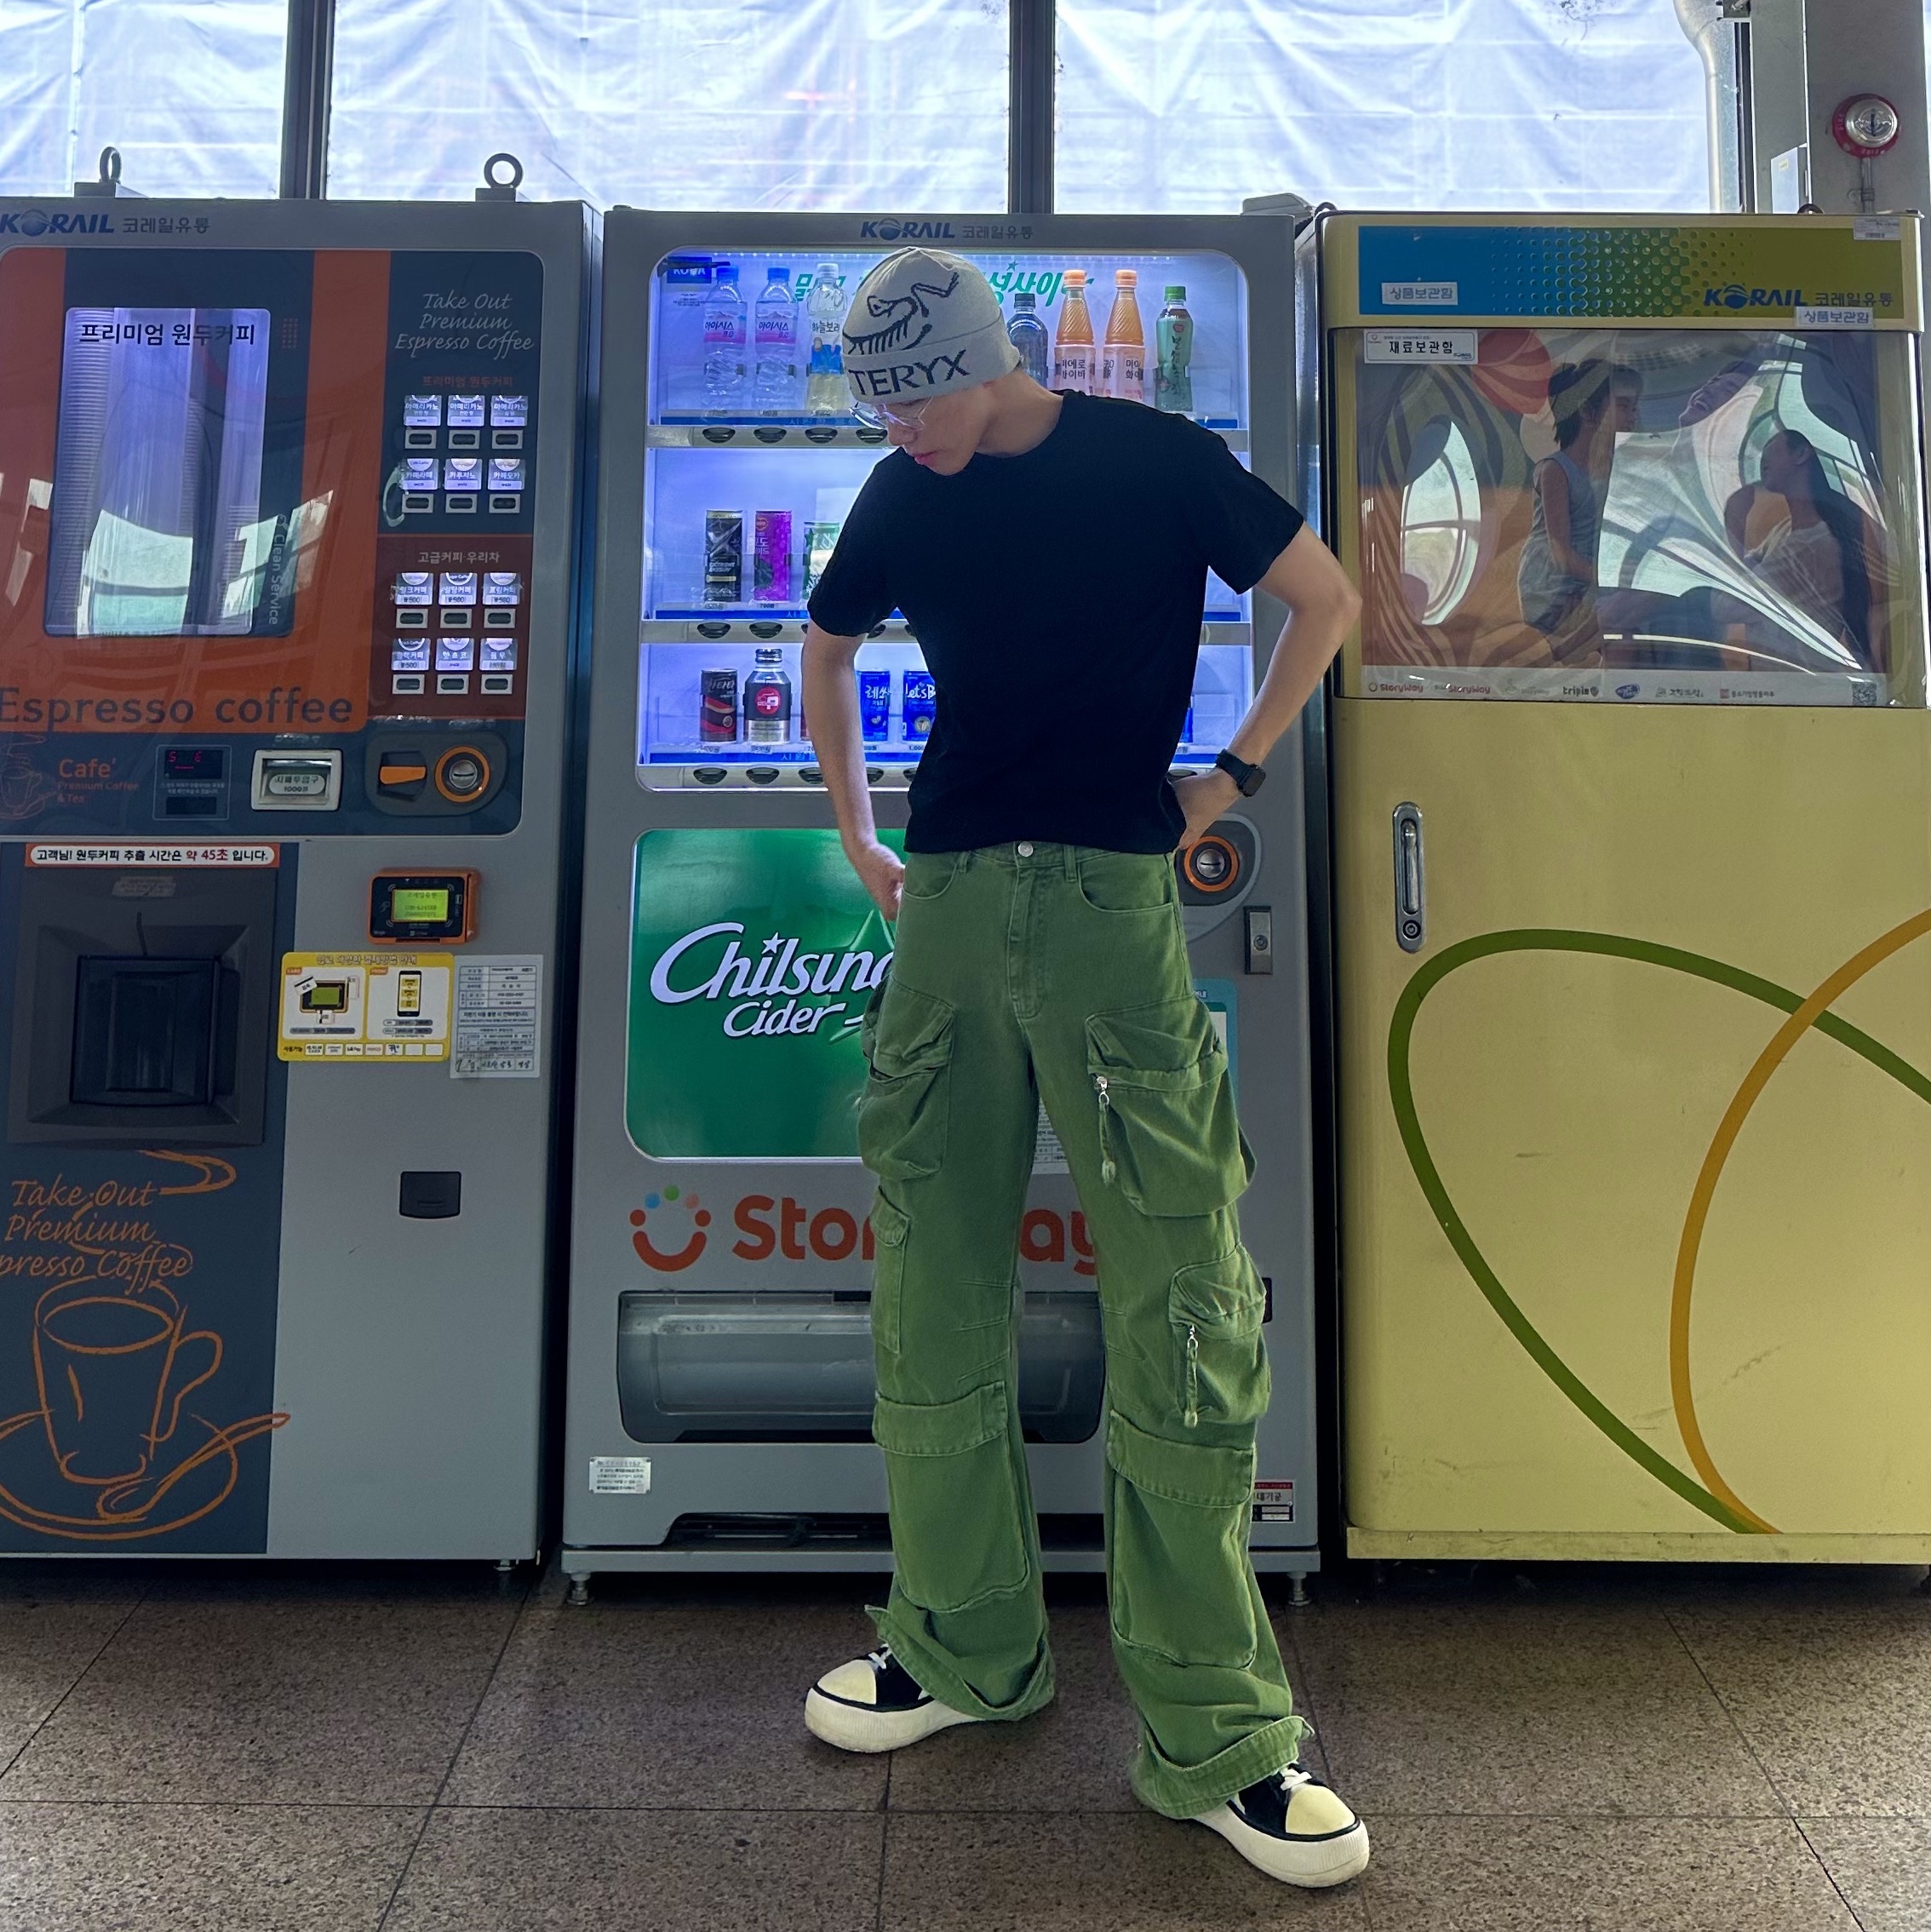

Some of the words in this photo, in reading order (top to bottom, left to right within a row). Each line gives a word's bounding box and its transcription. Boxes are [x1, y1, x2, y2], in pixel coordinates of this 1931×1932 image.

[0, 209, 114, 237] KORAIL
[123, 217, 210, 234] 코레일유통
[860, 217, 955, 241] KORAIL
[961, 226, 1034, 240] 코레일유통
[423, 290, 470, 310] Take
[473, 293, 513, 310] Out
[1390, 287, 1453, 300] 상품보관함
[1704, 284, 1808, 309] KORAIL
[1815, 292, 1894, 307] 코레일유통
[419, 312, 513, 330] Premium
[1804, 310, 1870, 324] 상품보관함
[79, 324, 163, 346] 프리미엄
[171, 324, 255, 346] 원두커피
[394, 333, 469, 358] Espresso
[476, 330, 535, 360] Coffee
[1389, 341, 1453, 354] 재료보관함
[422, 376, 467, 387] 프리미엄
[470, 376, 513, 387] 원두커피
[848, 348, 971, 396] TERYX
[272, 534, 285, 571] Clean
[268, 575, 281, 625] Service
[0, 686, 194, 731] Espresso
[215, 686, 352, 724] coffee
[58, 781, 103, 790] Premium
[105, 781, 139, 790] Coffee
[68, 794, 84, 803] Tea
[36, 850, 72, 861] 고객님!
[76, 850, 119, 861] 원두커피
[124, 850, 145, 861] 추출
[149, 850, 182, 861] 시간은
[186, 850, 198, 861] 약
[200, 849, 228, 861] 45초
[232, 850, 269, 861] 입니다.
[724, 999, 847, 1037] Cider
[11, 1172, 85, 1207] Take
[95, 1180, 158, 1207] Out
[4, 1212, 156, 1241] Premium
[96, 1243, 189, 1296] Coffee
